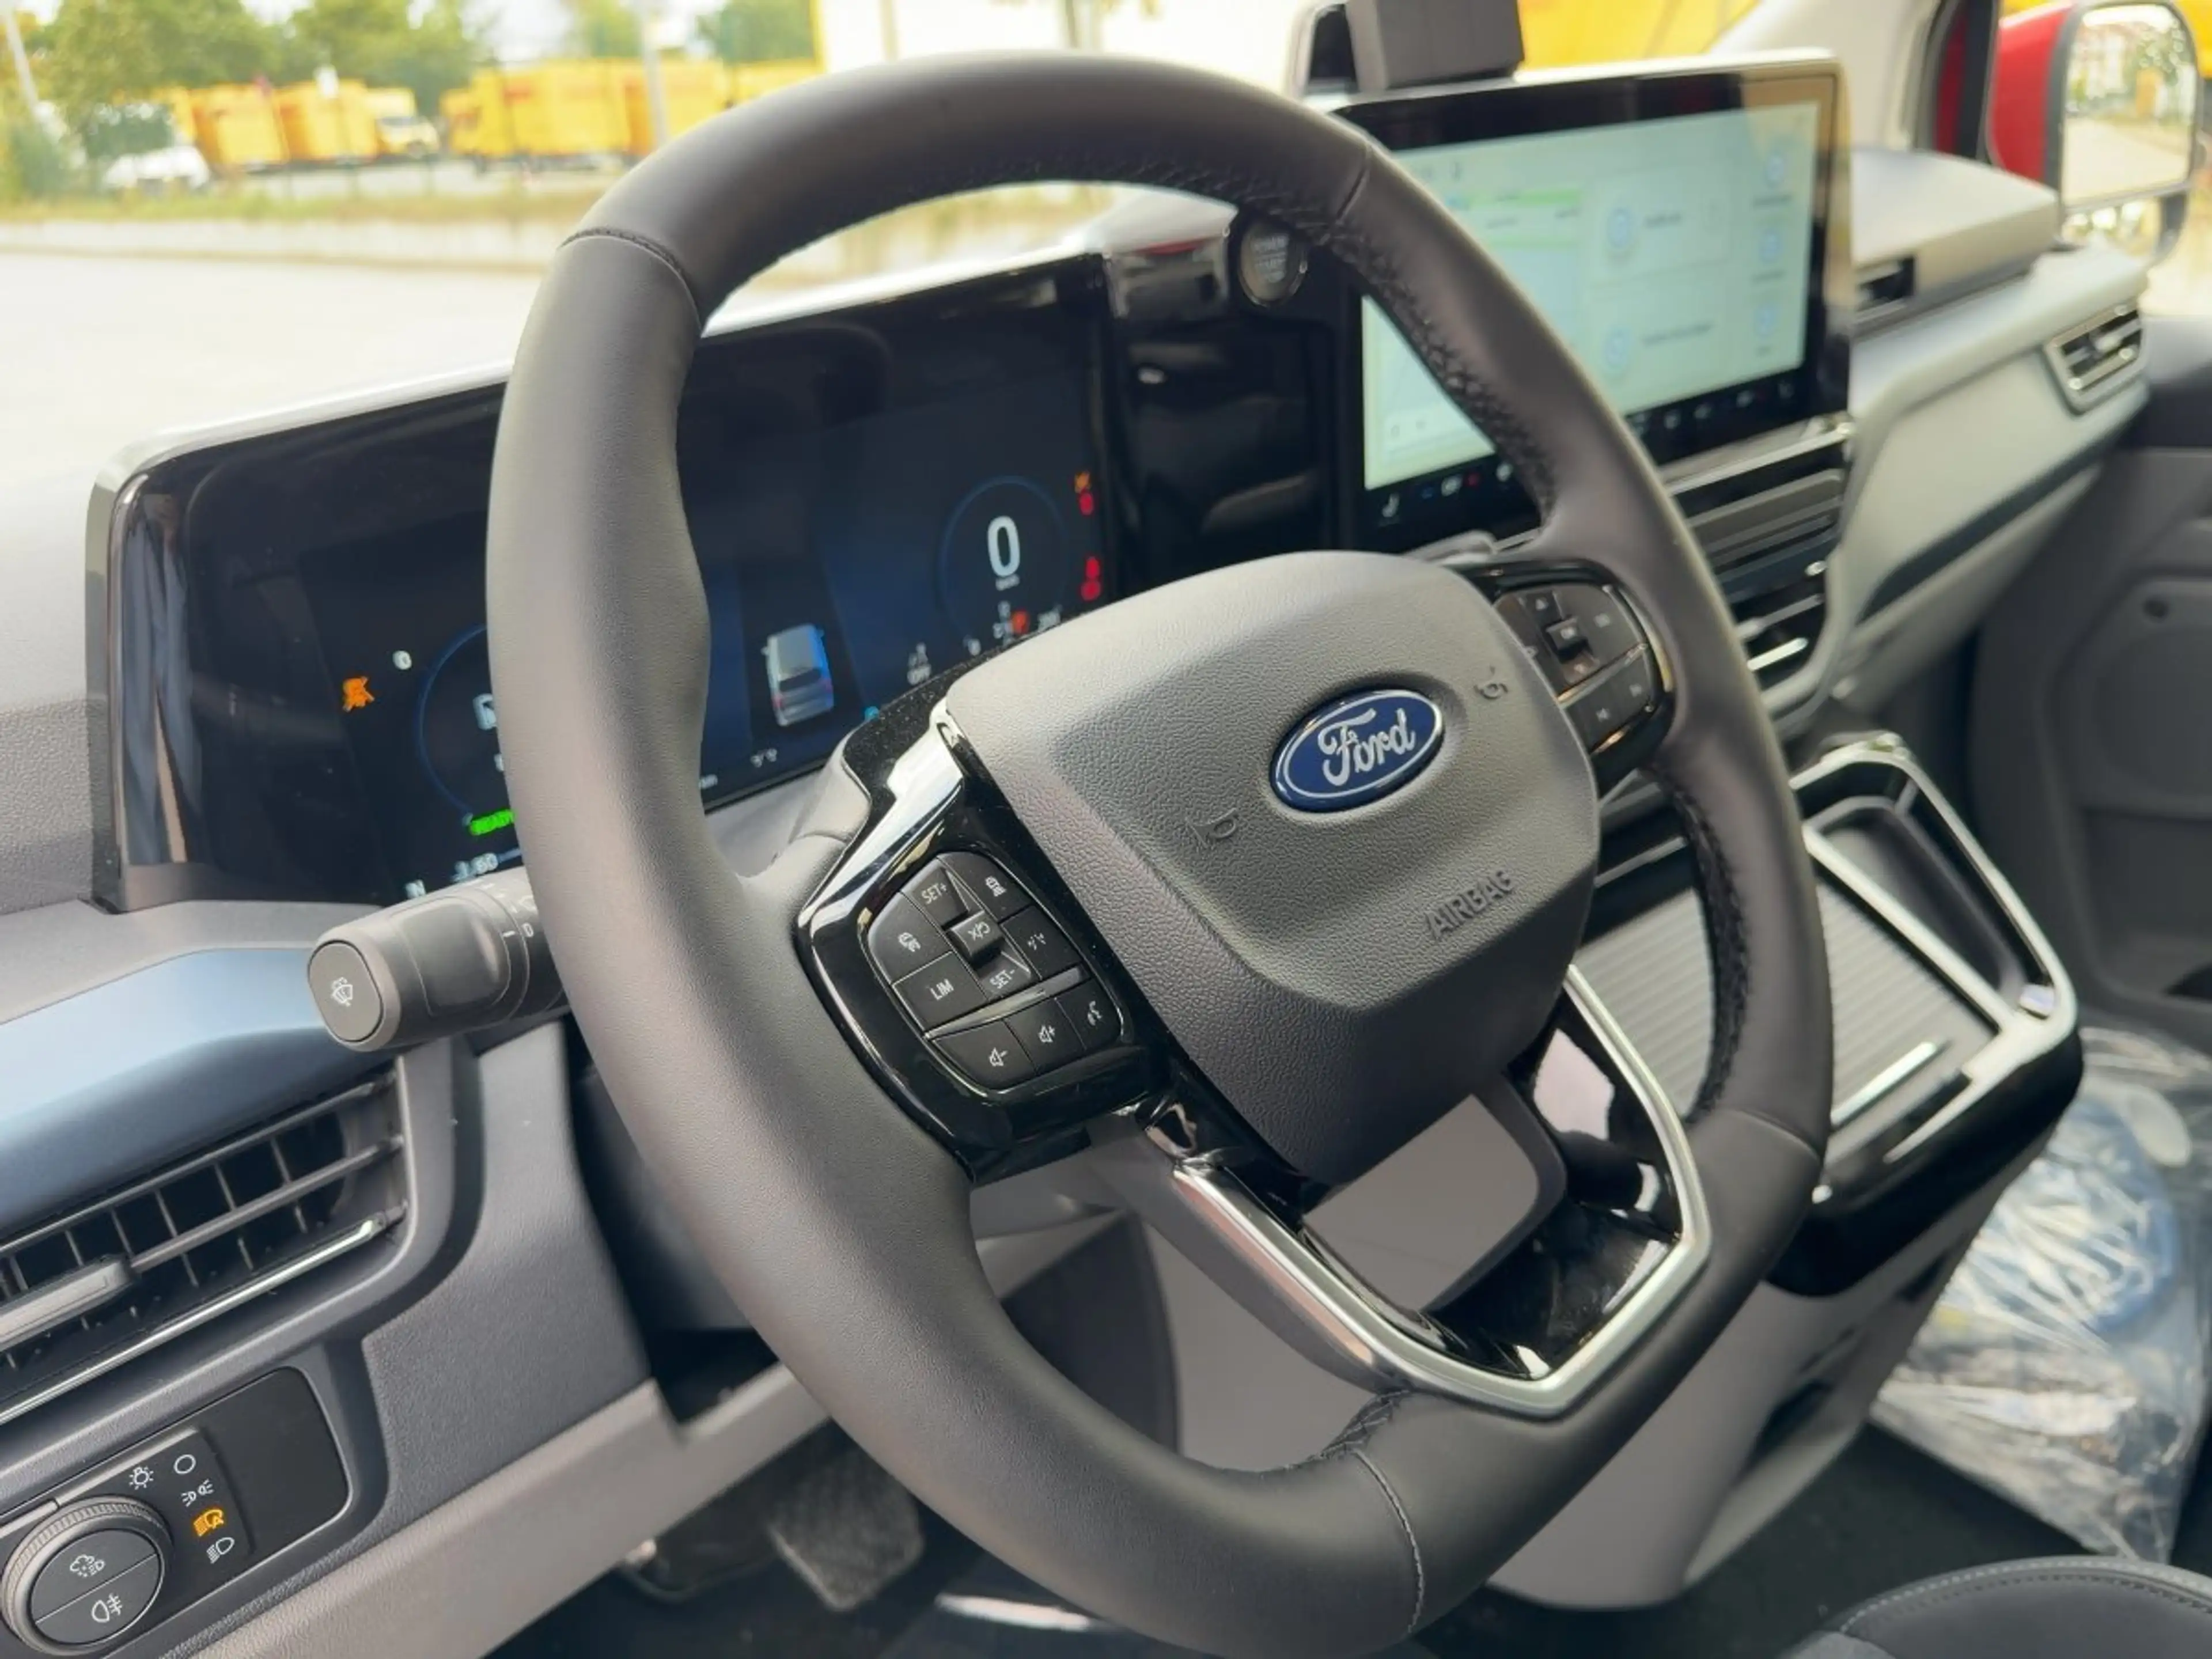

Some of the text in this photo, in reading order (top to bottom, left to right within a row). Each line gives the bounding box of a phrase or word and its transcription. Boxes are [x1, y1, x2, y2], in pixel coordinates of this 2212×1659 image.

[987, 516, 1020, 577] 0
[1317, 707, 1416, 786] Ford
[922, 882, 947, 904] SET+
[1423, 869, 1514, 940] AIRBAG
[929, 978, 955, 1001] LIM
[990, 969, 1015, 989] SET-
